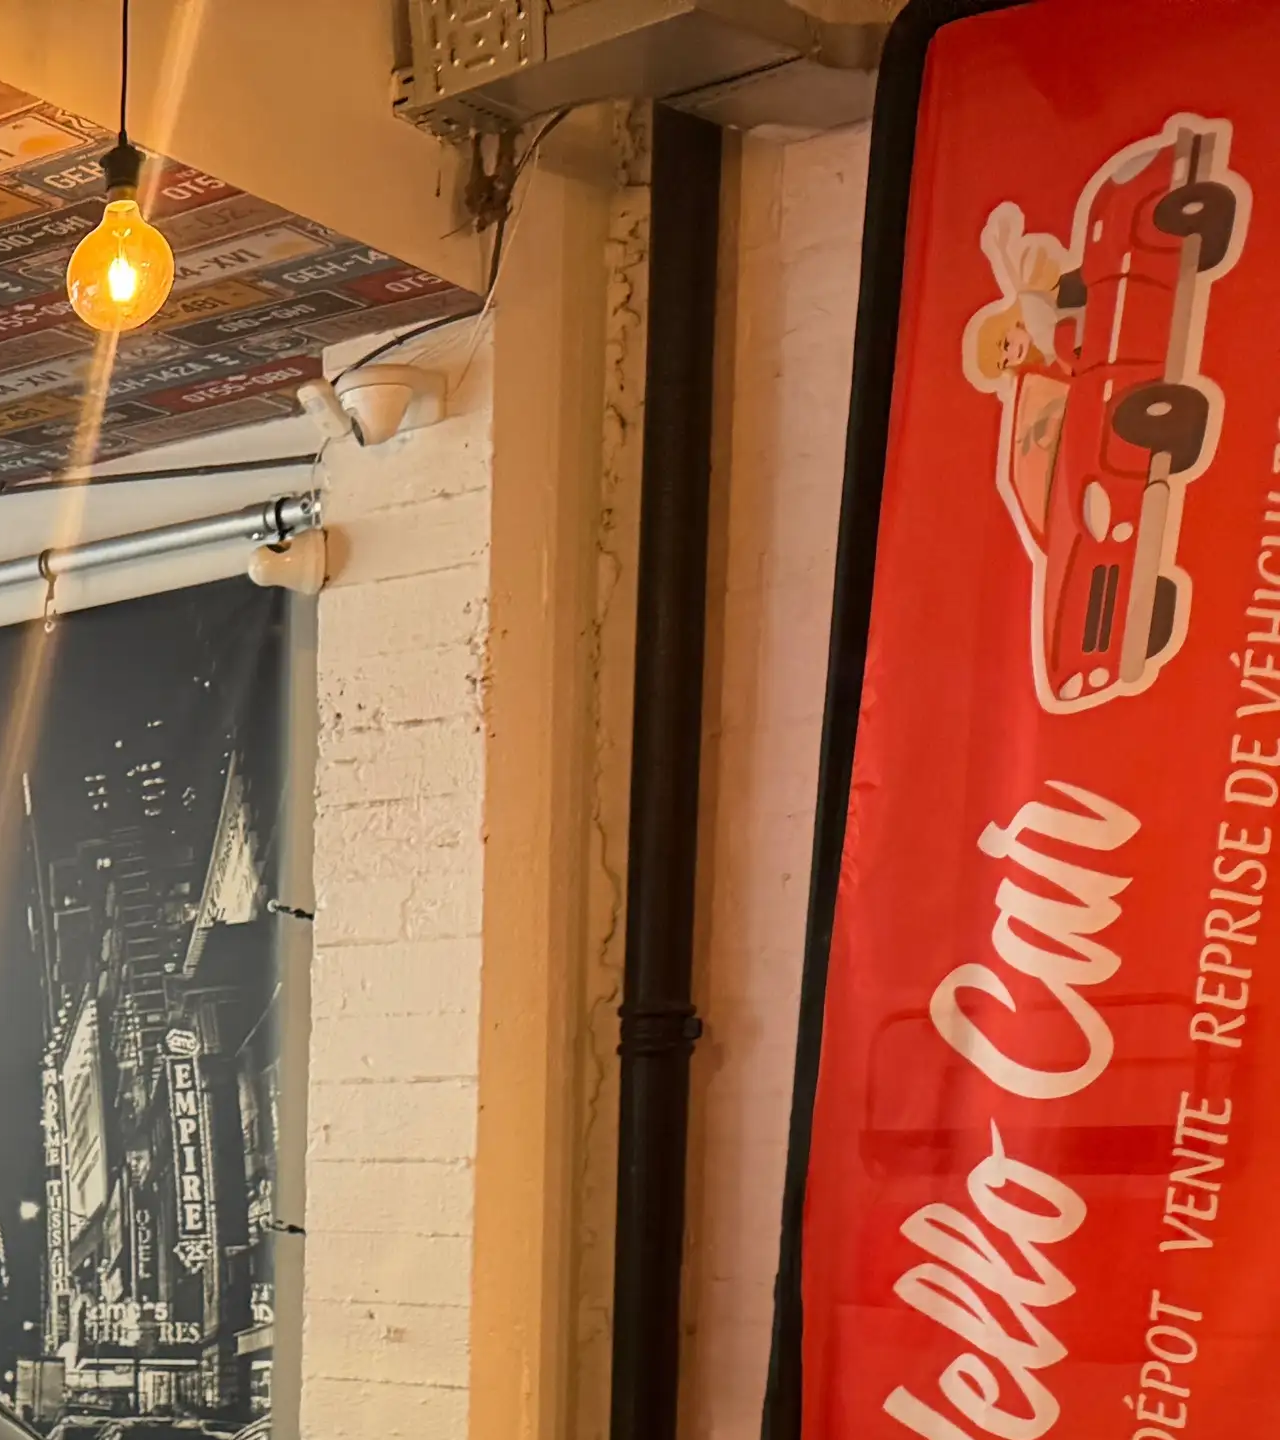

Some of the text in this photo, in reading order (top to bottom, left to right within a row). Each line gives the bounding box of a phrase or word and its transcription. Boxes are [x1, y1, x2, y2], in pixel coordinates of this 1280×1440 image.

[1224, 734, 1280, 808] DE
[929, 778, 1143, 1099] Car
[1190, 821, 1273, 1050] REPRISE
[174, 1063, 203, 1231] EMPIRE
[1159, 1091, 1233, 1253] VENTE
